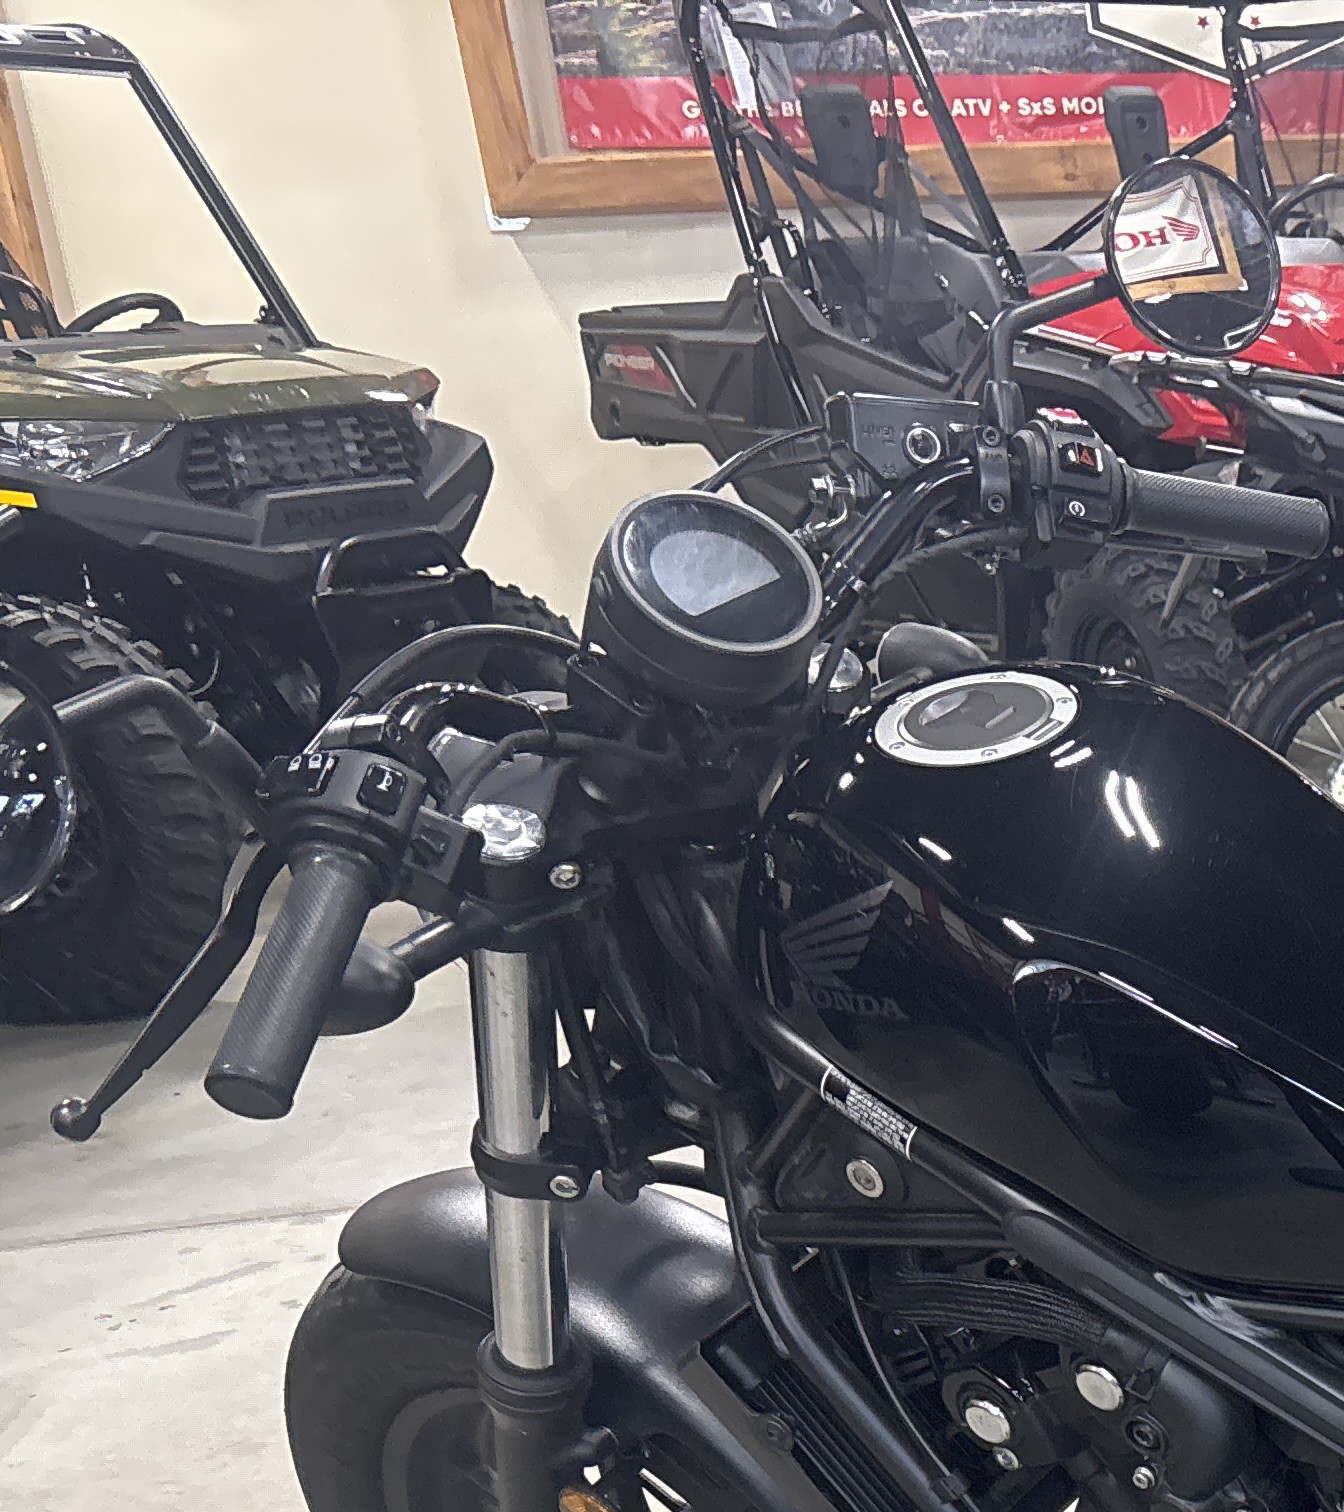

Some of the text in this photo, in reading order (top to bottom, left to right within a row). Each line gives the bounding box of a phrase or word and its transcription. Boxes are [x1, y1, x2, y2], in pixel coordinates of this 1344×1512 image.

[950, 98, 993, 118] ATV
[1017, 97, 1057, 117] SxS
[282, 502, 412, 531] POLARIS
